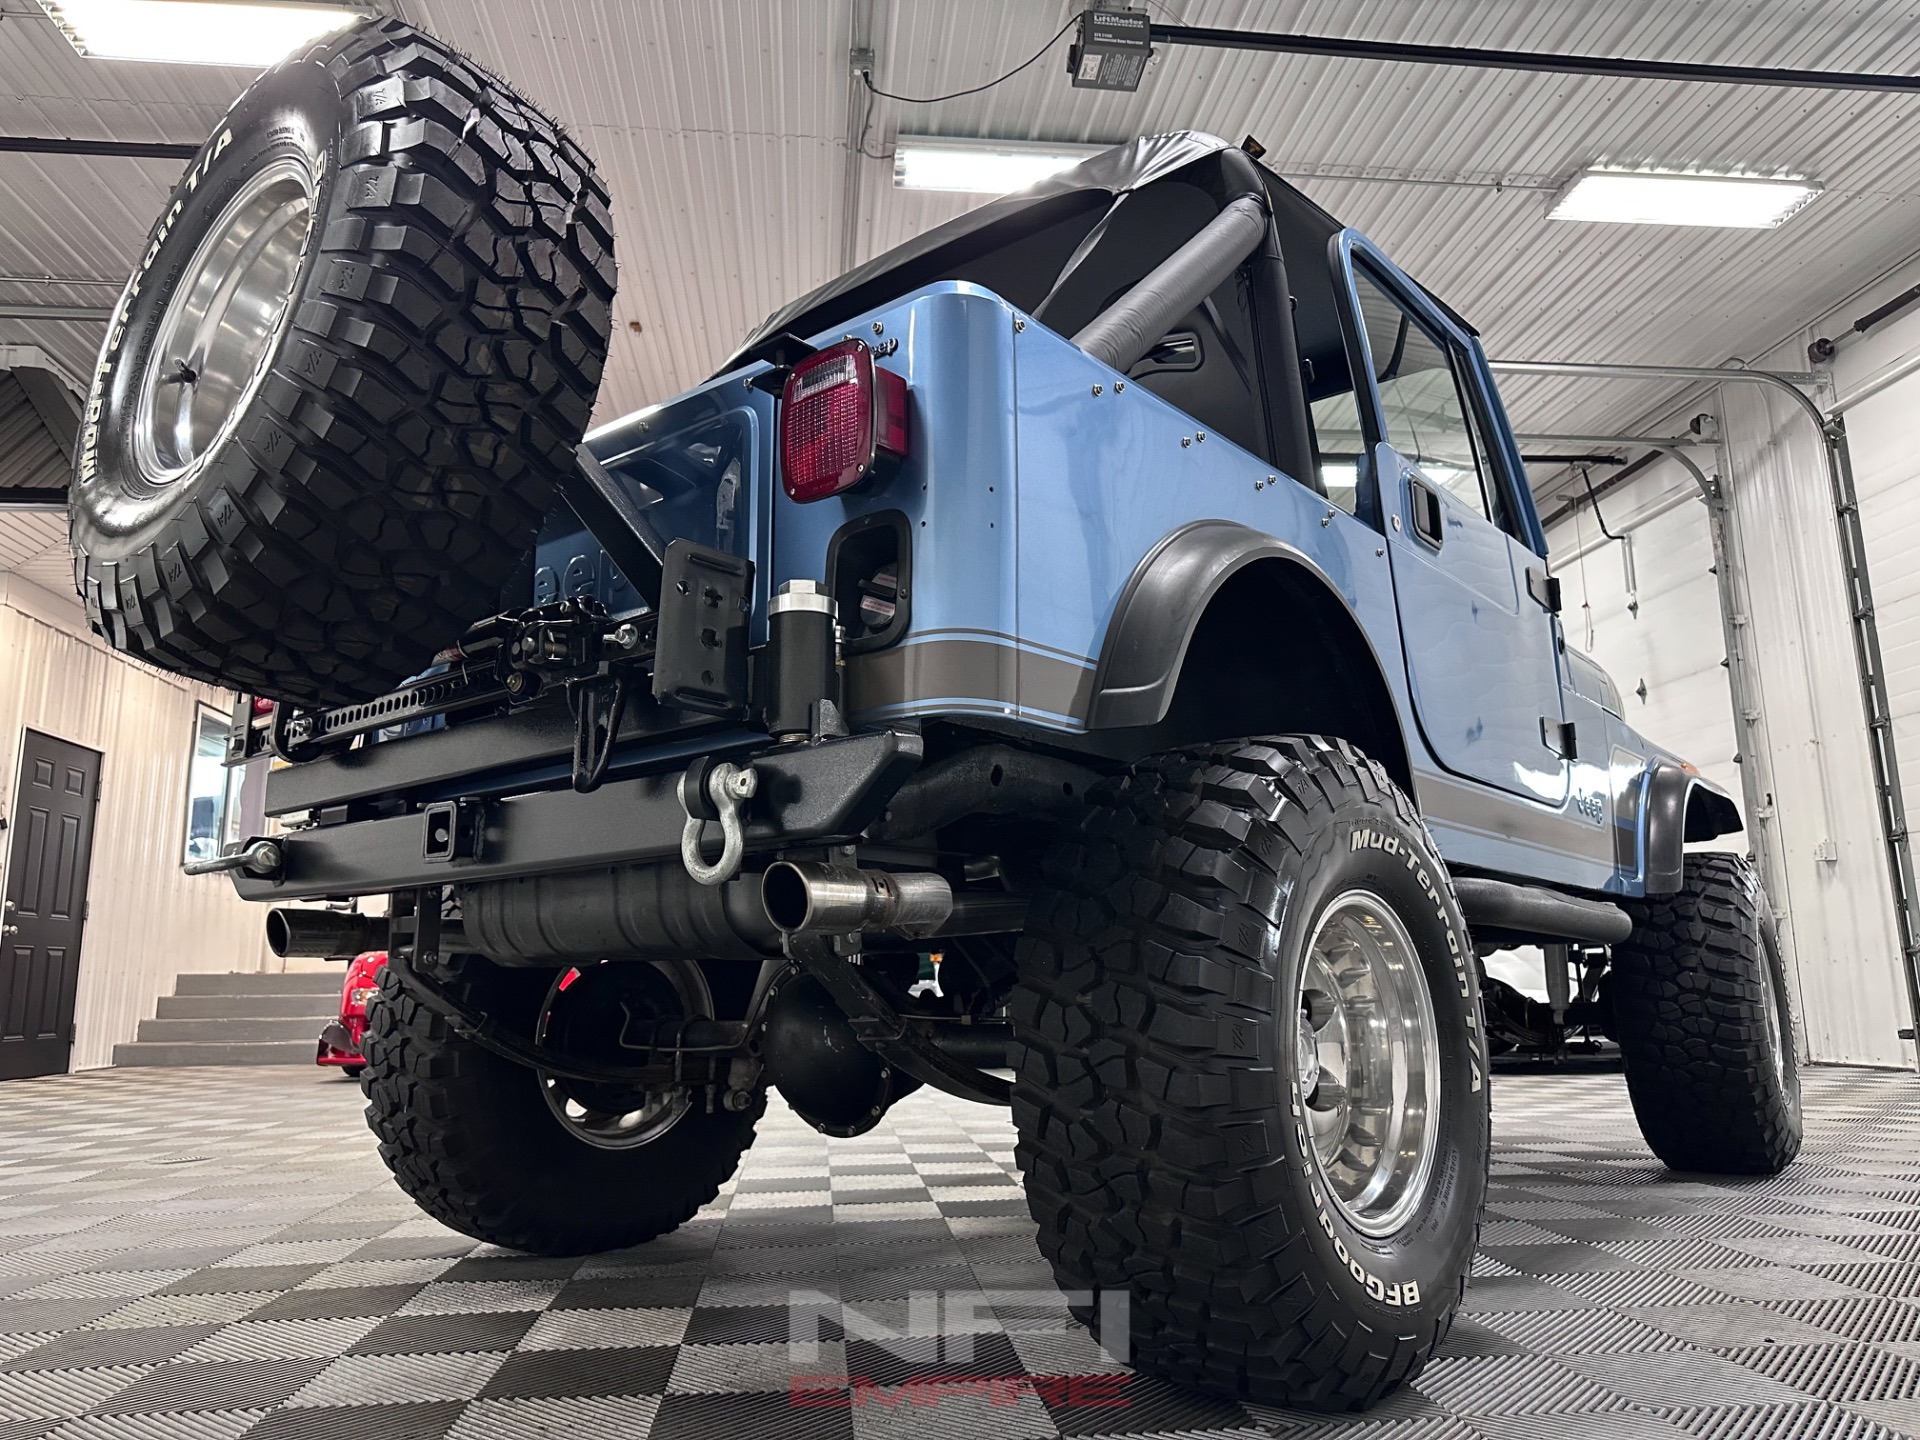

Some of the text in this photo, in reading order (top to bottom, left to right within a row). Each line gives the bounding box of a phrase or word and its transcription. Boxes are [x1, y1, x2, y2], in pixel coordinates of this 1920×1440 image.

[1094, 14, 1143, 25] LiftMaster
[81, 199, 185, 484] Mud-Terrain
[185, 128, 233, 193] T/A
[1350, 827, 1471, 999] Mud-Terrain
[1464, 1007, 1482, 1094] T/A
